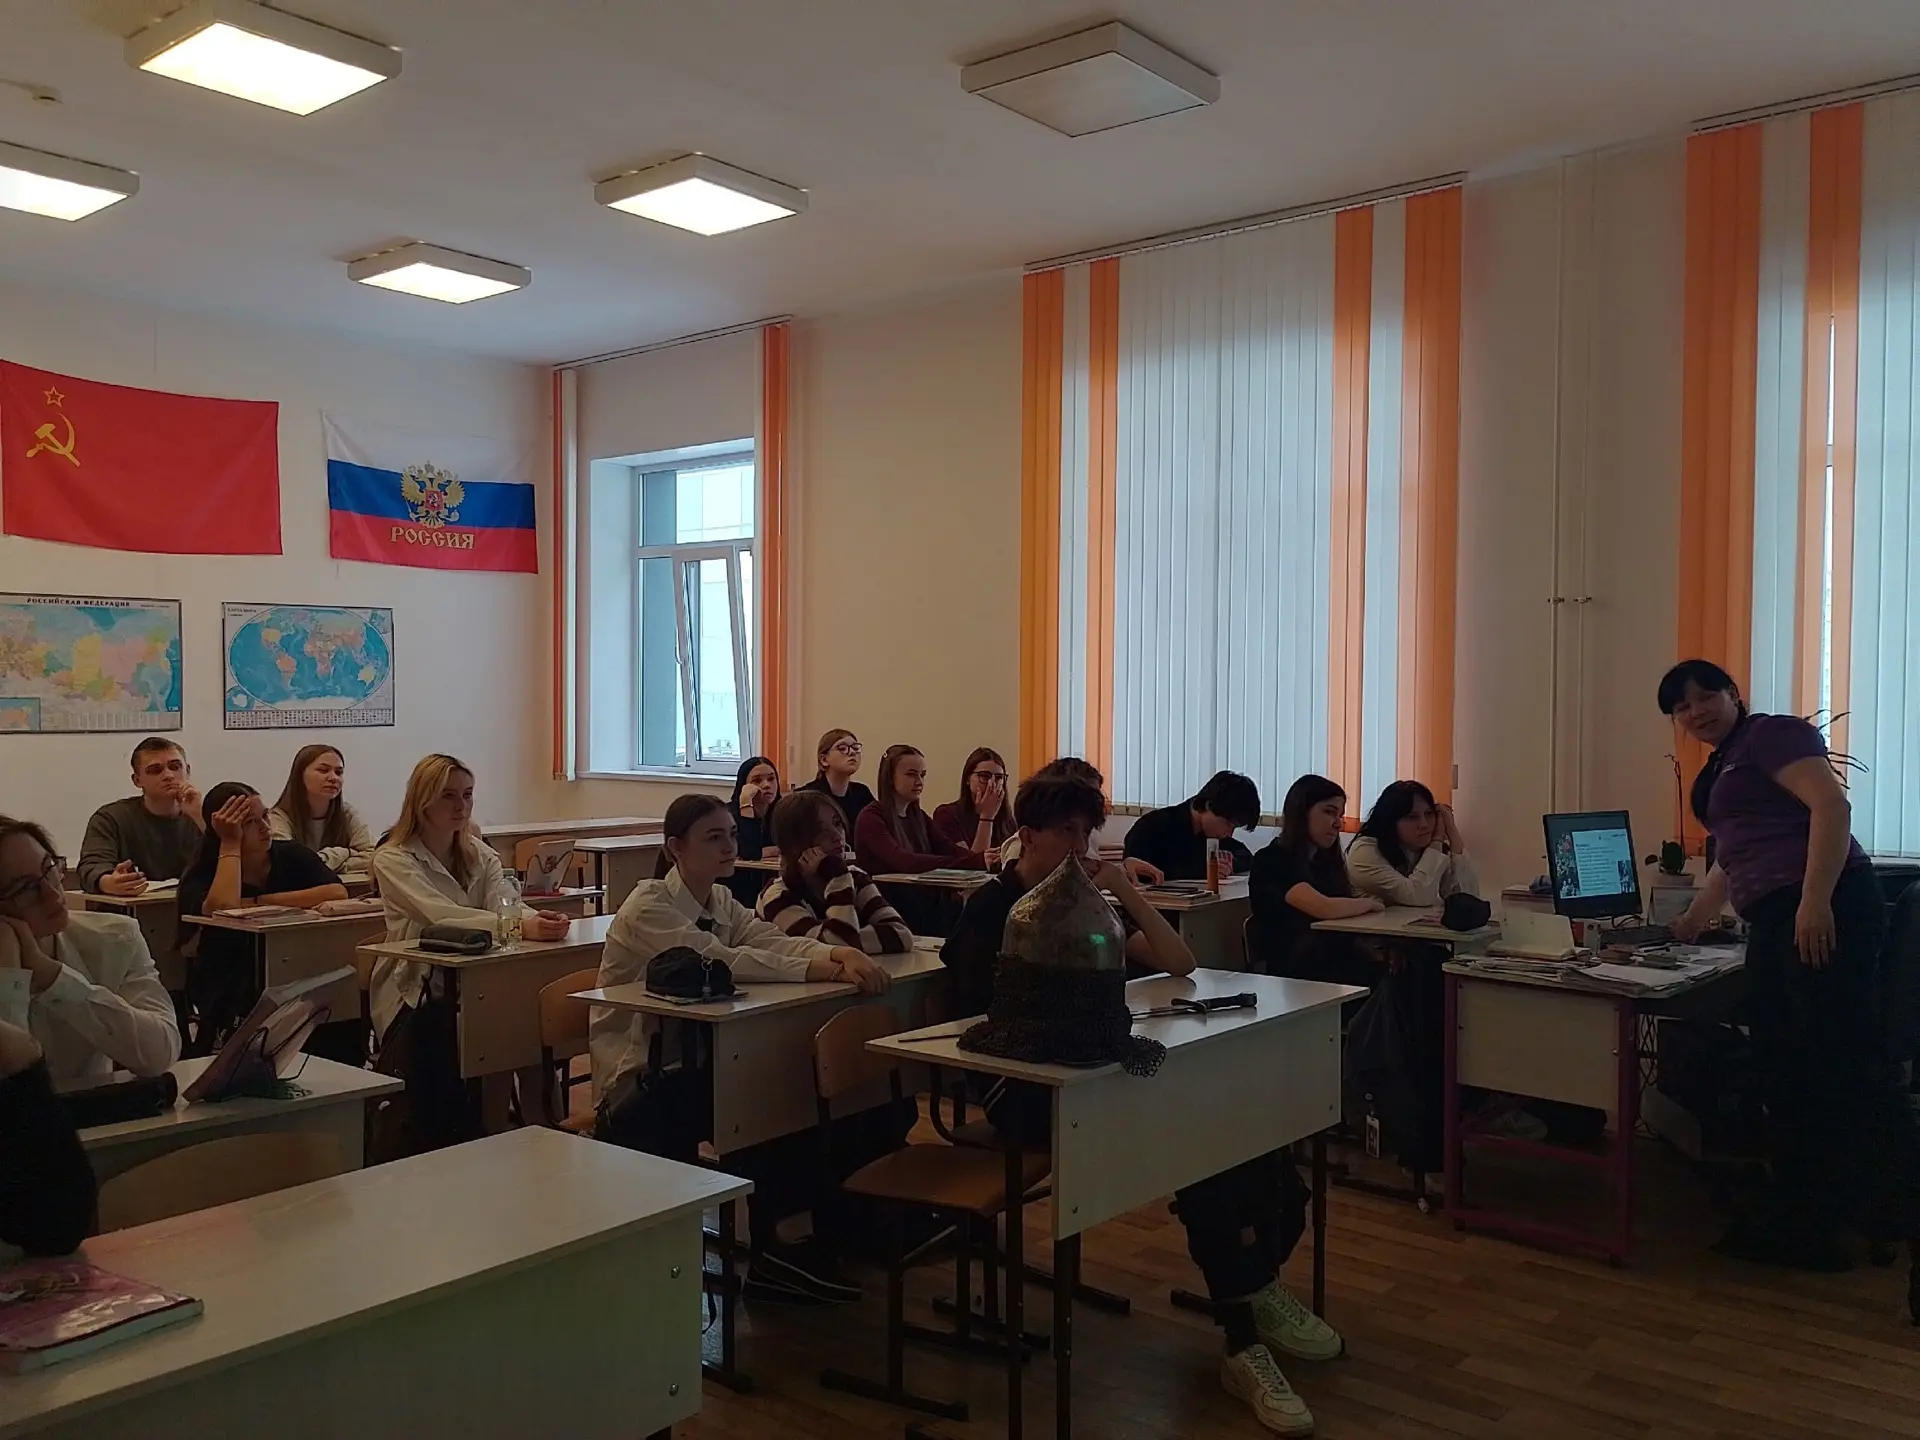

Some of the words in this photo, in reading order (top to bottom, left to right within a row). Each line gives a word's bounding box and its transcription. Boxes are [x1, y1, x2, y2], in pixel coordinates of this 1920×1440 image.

[390, 526, 475, 549] РОССИЯ
[26, 597, 81, 605] РОССИЙСКАЯ
[83, 600, 130, 608] ФЕДЕРАЦИЯ
